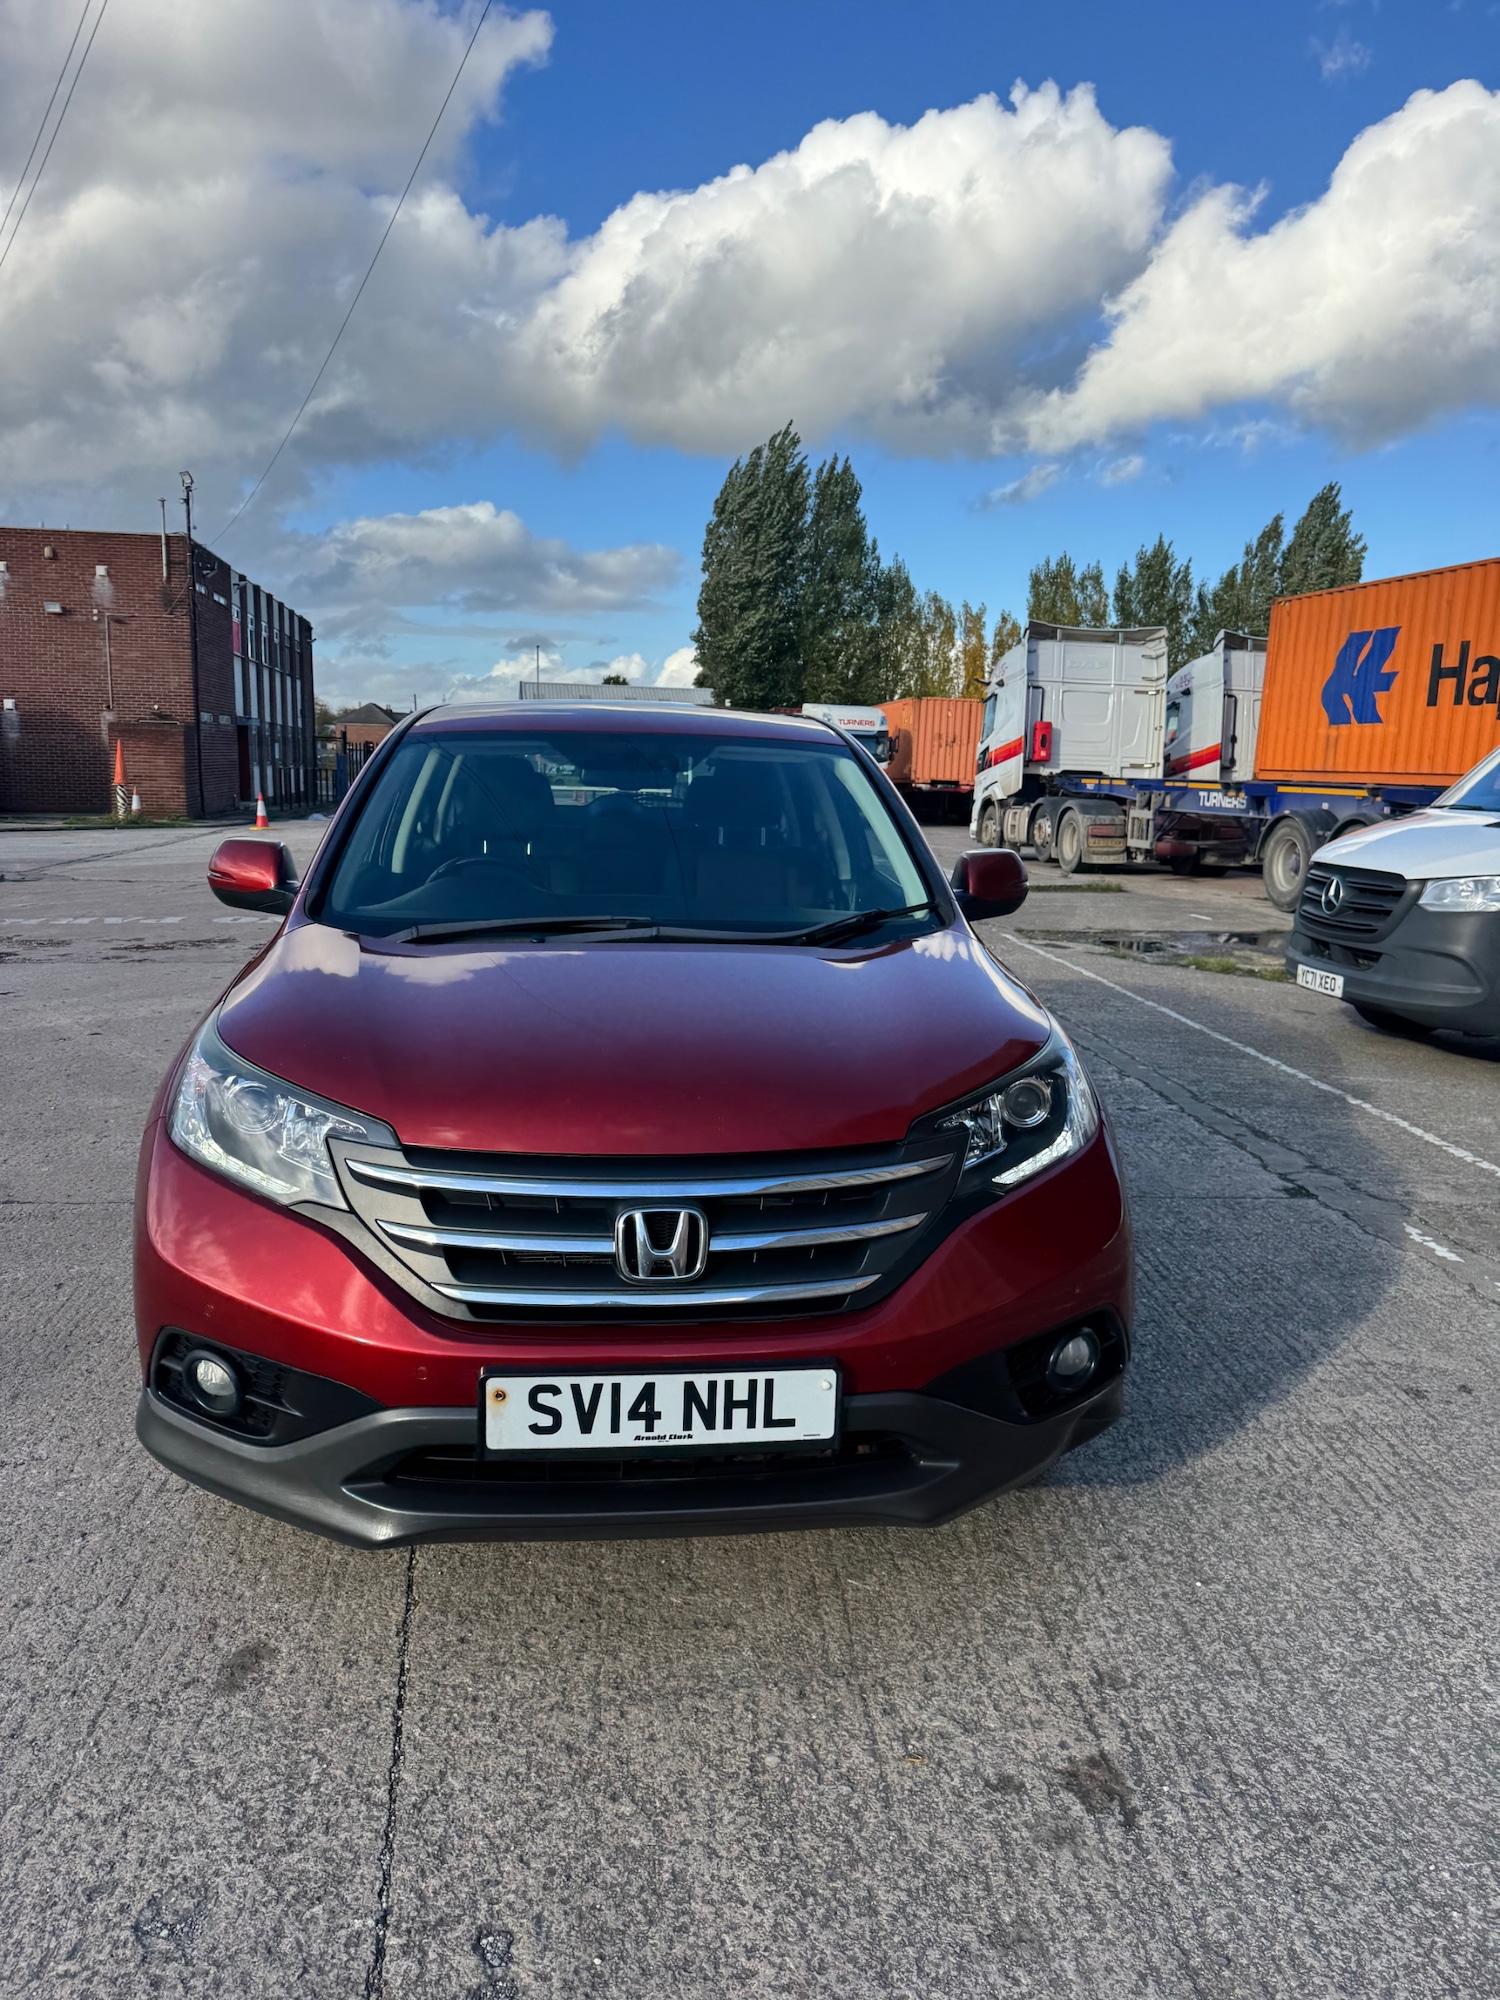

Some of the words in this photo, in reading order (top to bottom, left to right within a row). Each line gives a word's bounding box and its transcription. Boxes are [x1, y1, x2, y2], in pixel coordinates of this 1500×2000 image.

[1426, 641, 1500, 720] Ha
[838, 718, 876, 727] TURNERS
[1199, 791, 1248, 809] TURNERS
[1301, 968, 1317, 988] YC71
[1318, 973, 1337, 992] XEO
[527, 1382, 662, 1435] SV14
[682, 1378, 796, 1431] NHL
